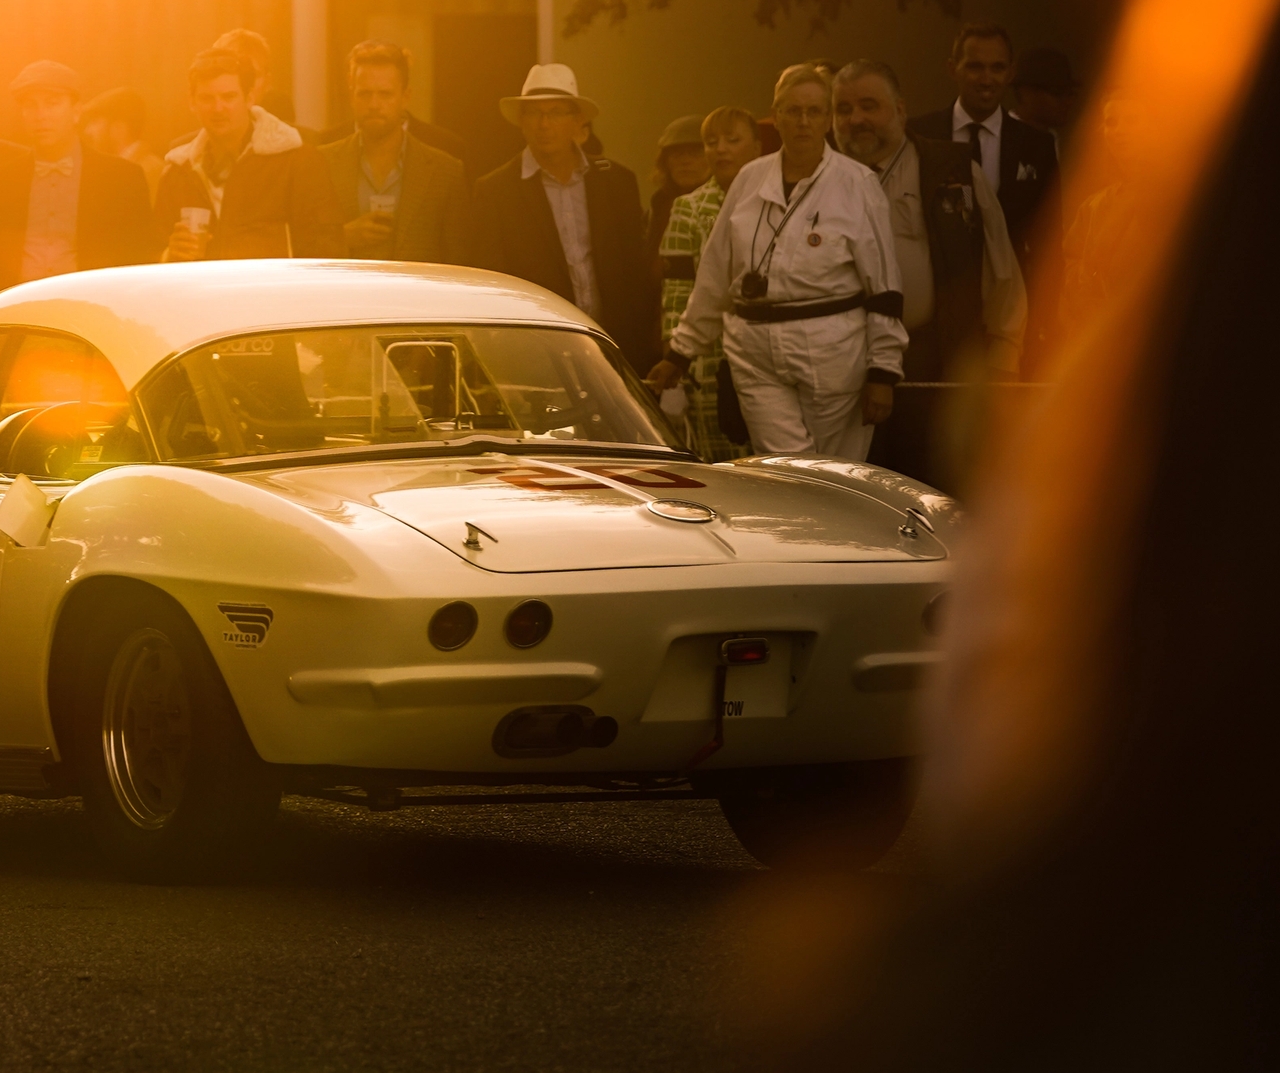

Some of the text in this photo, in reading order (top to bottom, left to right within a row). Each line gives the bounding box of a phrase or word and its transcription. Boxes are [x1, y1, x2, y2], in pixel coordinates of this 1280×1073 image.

[209, 339, 274, 352] parco
[465, 465, 707, 492] 20
[223, 633, 257, 643] TAYLOR
[722, 700, 744, 716] TOW
